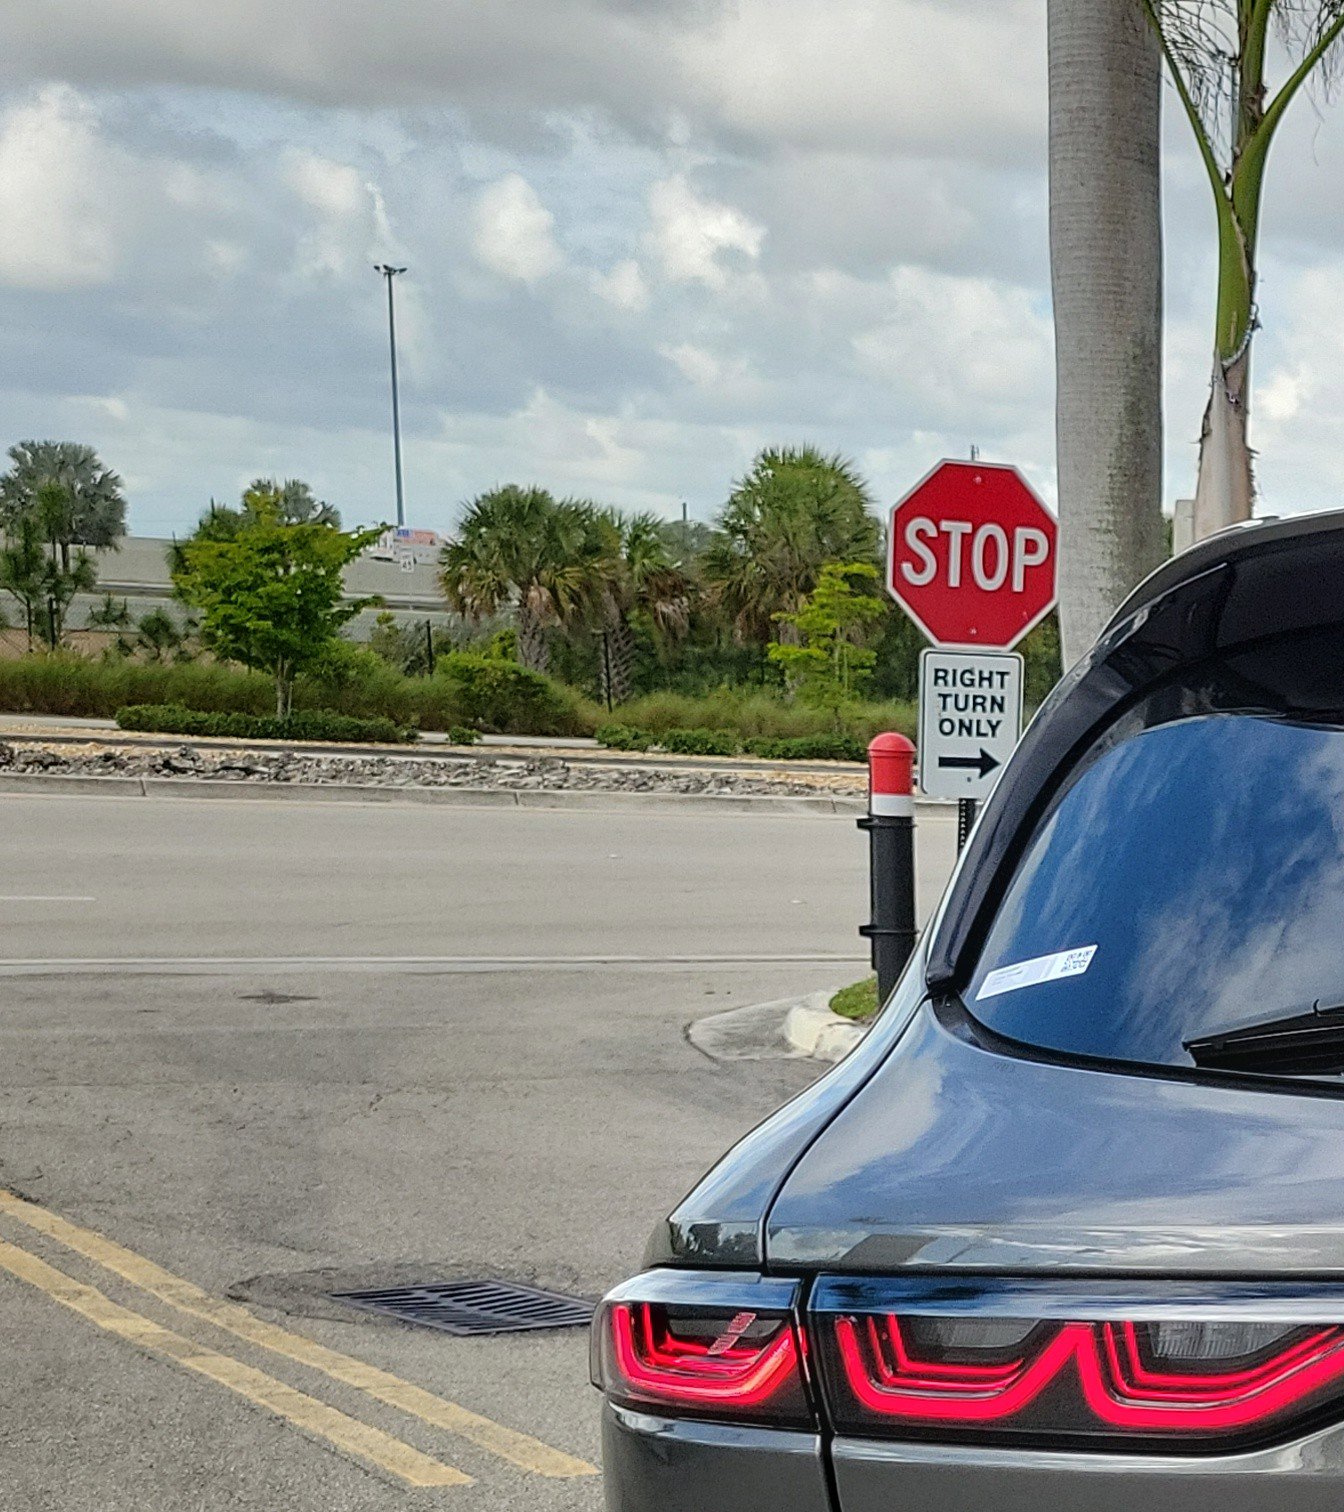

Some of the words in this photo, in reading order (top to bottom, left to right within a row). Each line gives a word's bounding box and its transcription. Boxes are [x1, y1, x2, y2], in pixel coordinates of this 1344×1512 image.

[900, 516, 1050, 593] STOP
[933, 668, 1011, 691] RIGHT
[938, 693, 1006, 714] TURN
[938, 717, 1002, 739] ONLY
